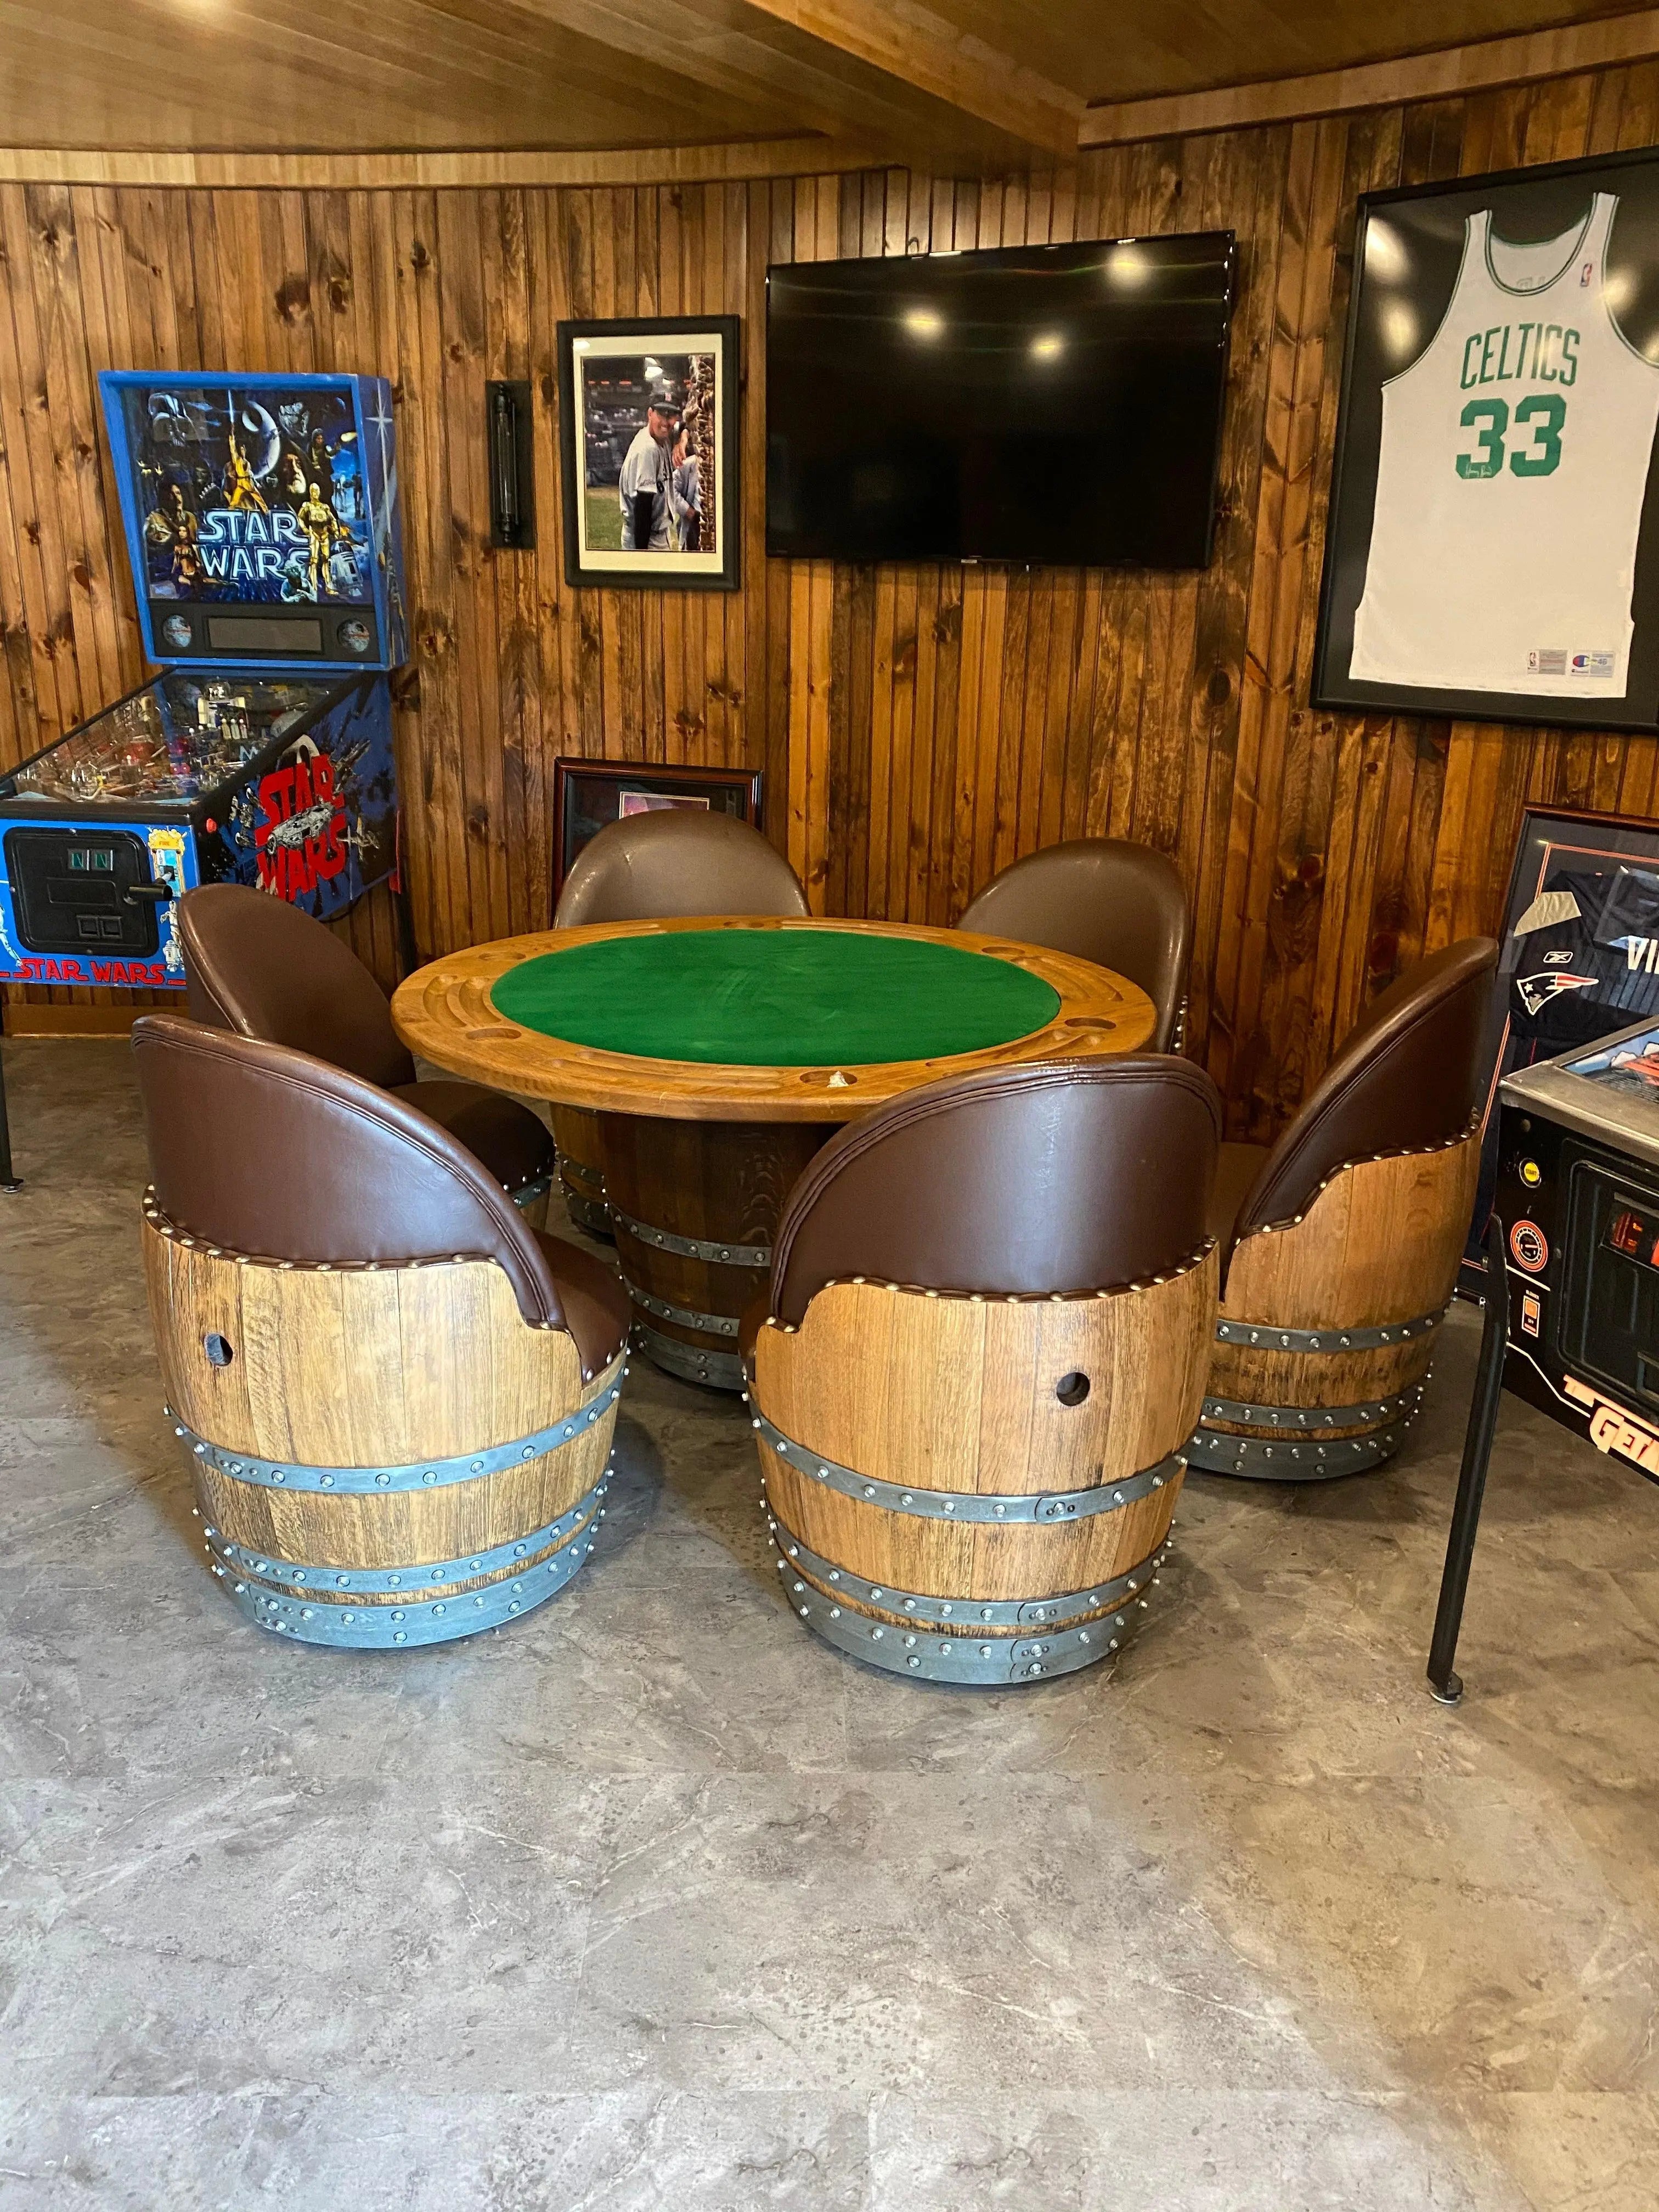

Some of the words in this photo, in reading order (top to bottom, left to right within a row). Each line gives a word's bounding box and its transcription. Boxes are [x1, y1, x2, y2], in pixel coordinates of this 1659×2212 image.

[1460, 323, 1581, 390] CELTICS
[1455, 393, 1567, 480] 33
[197, 509, 311, 545] STAR
[254, 754, 345, 848] STAR
[256, 812, 347, 902] WARS
[13, 957, 89, 981] STAR
[90, 960, 167, 985] WARS
[1628, 935, 1659, 974] VI
